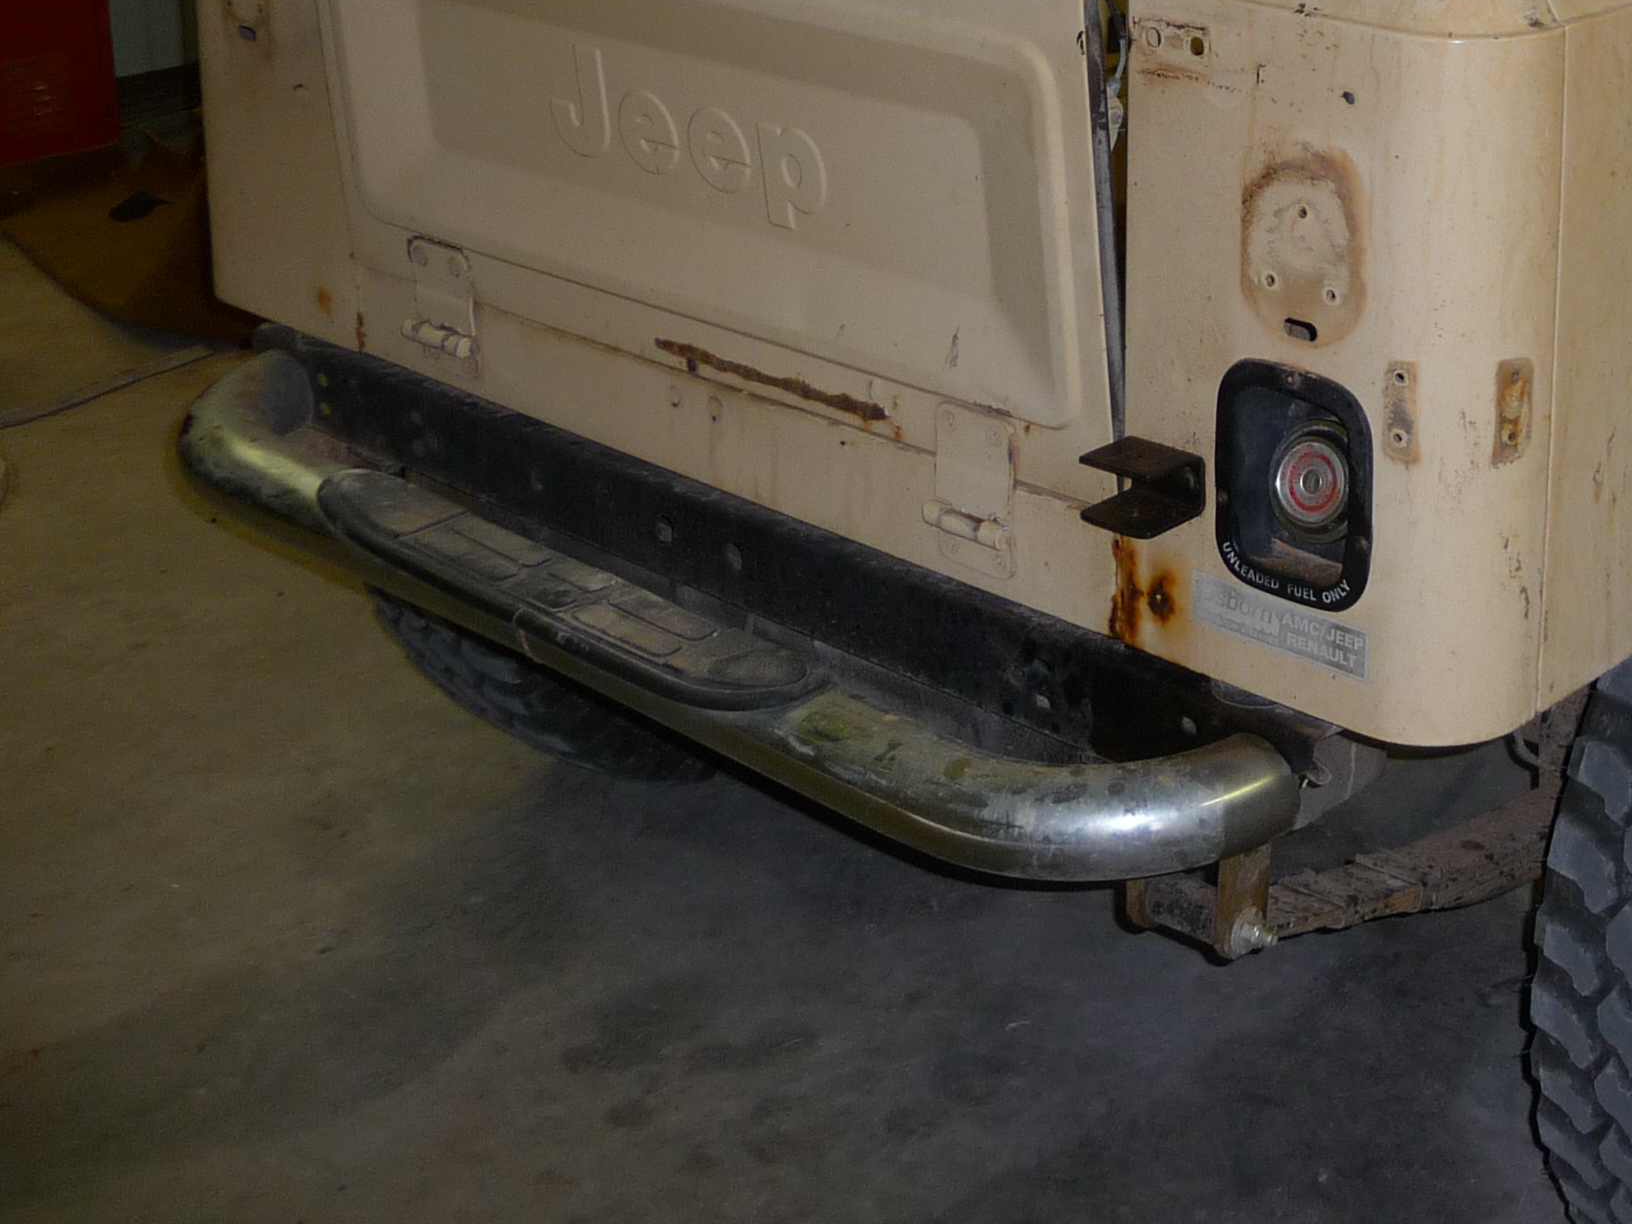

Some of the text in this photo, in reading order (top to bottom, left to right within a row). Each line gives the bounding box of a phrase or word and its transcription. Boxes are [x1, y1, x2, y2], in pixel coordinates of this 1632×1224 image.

[550, 42, 828, 231] Jeep
[1222, 541, 1351, 604] UNLEADED FUEL ONLY
[1281, 611, 1364, 651] AMC/JEEP
[1286, 631, 1358, 669] RENAULT
